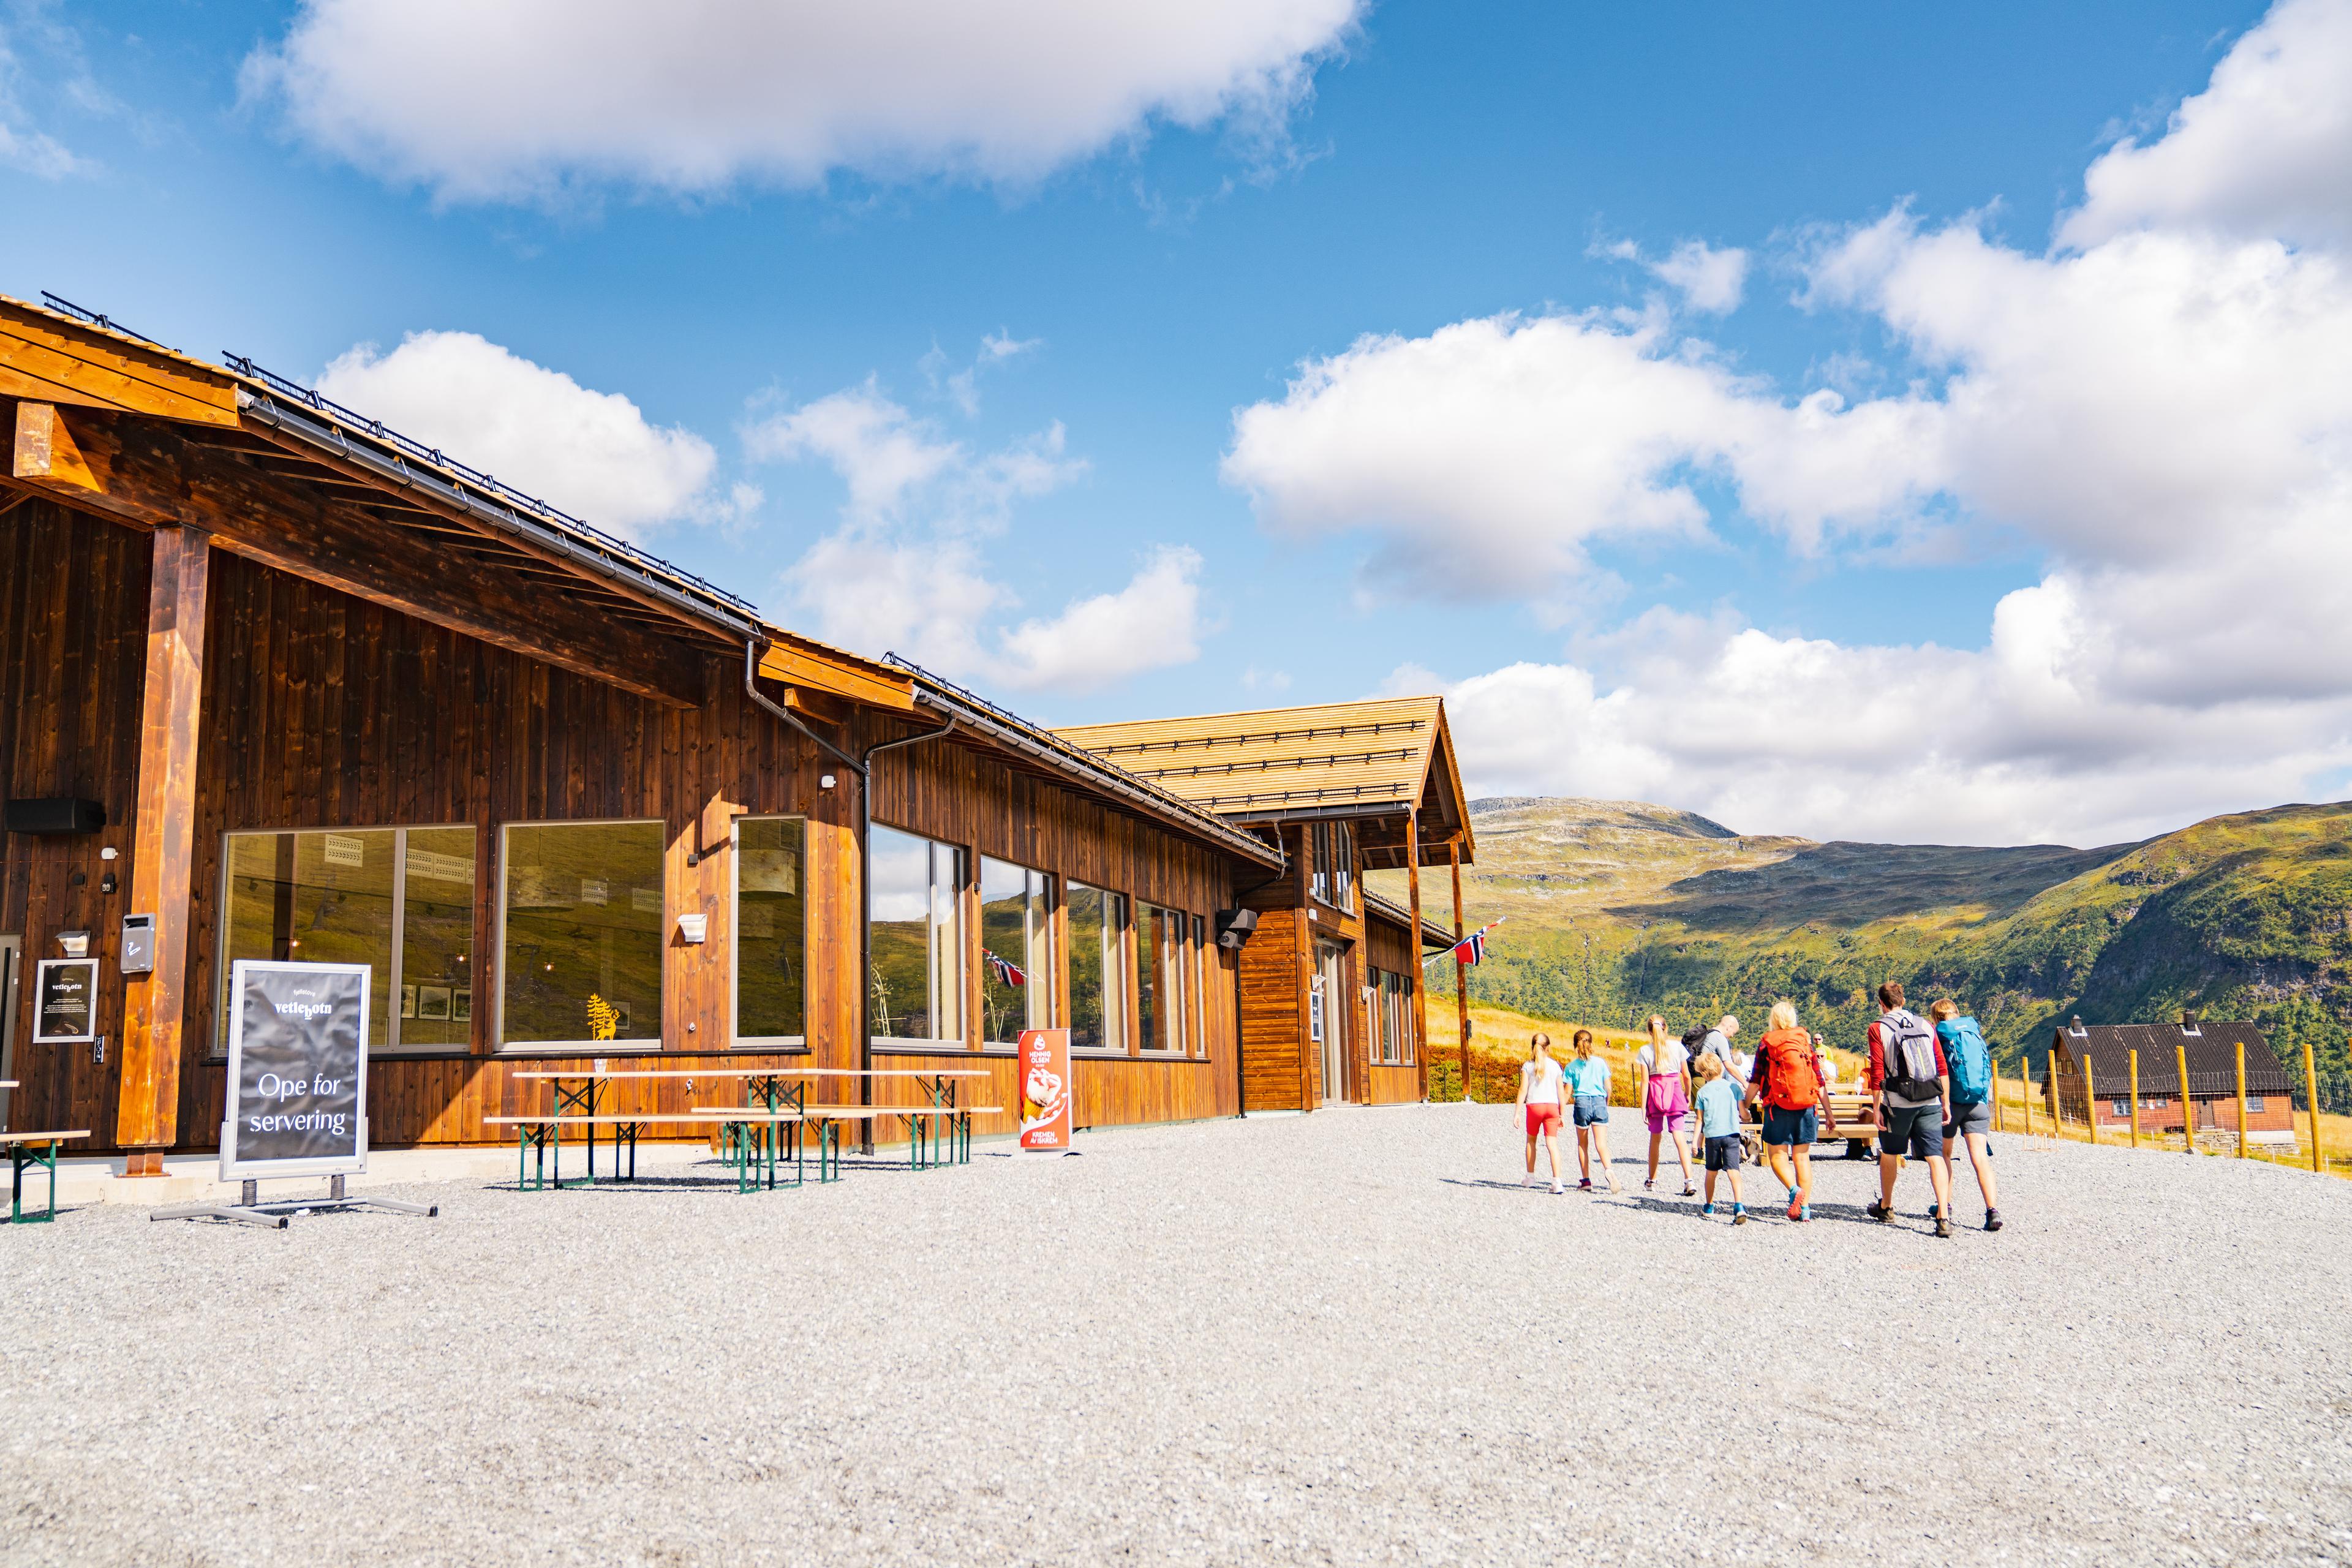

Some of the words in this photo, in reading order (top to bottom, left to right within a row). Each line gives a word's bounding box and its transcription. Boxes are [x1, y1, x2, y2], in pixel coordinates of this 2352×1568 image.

[52, 984, 82, 992] vetlebotn
[274, 1001, 332, 1020] vetlebotn
[258, 1073, 307, 1102] Ope
[314, 1073, 341, 1095] for
[250, 1109, 345, 1135] servering
